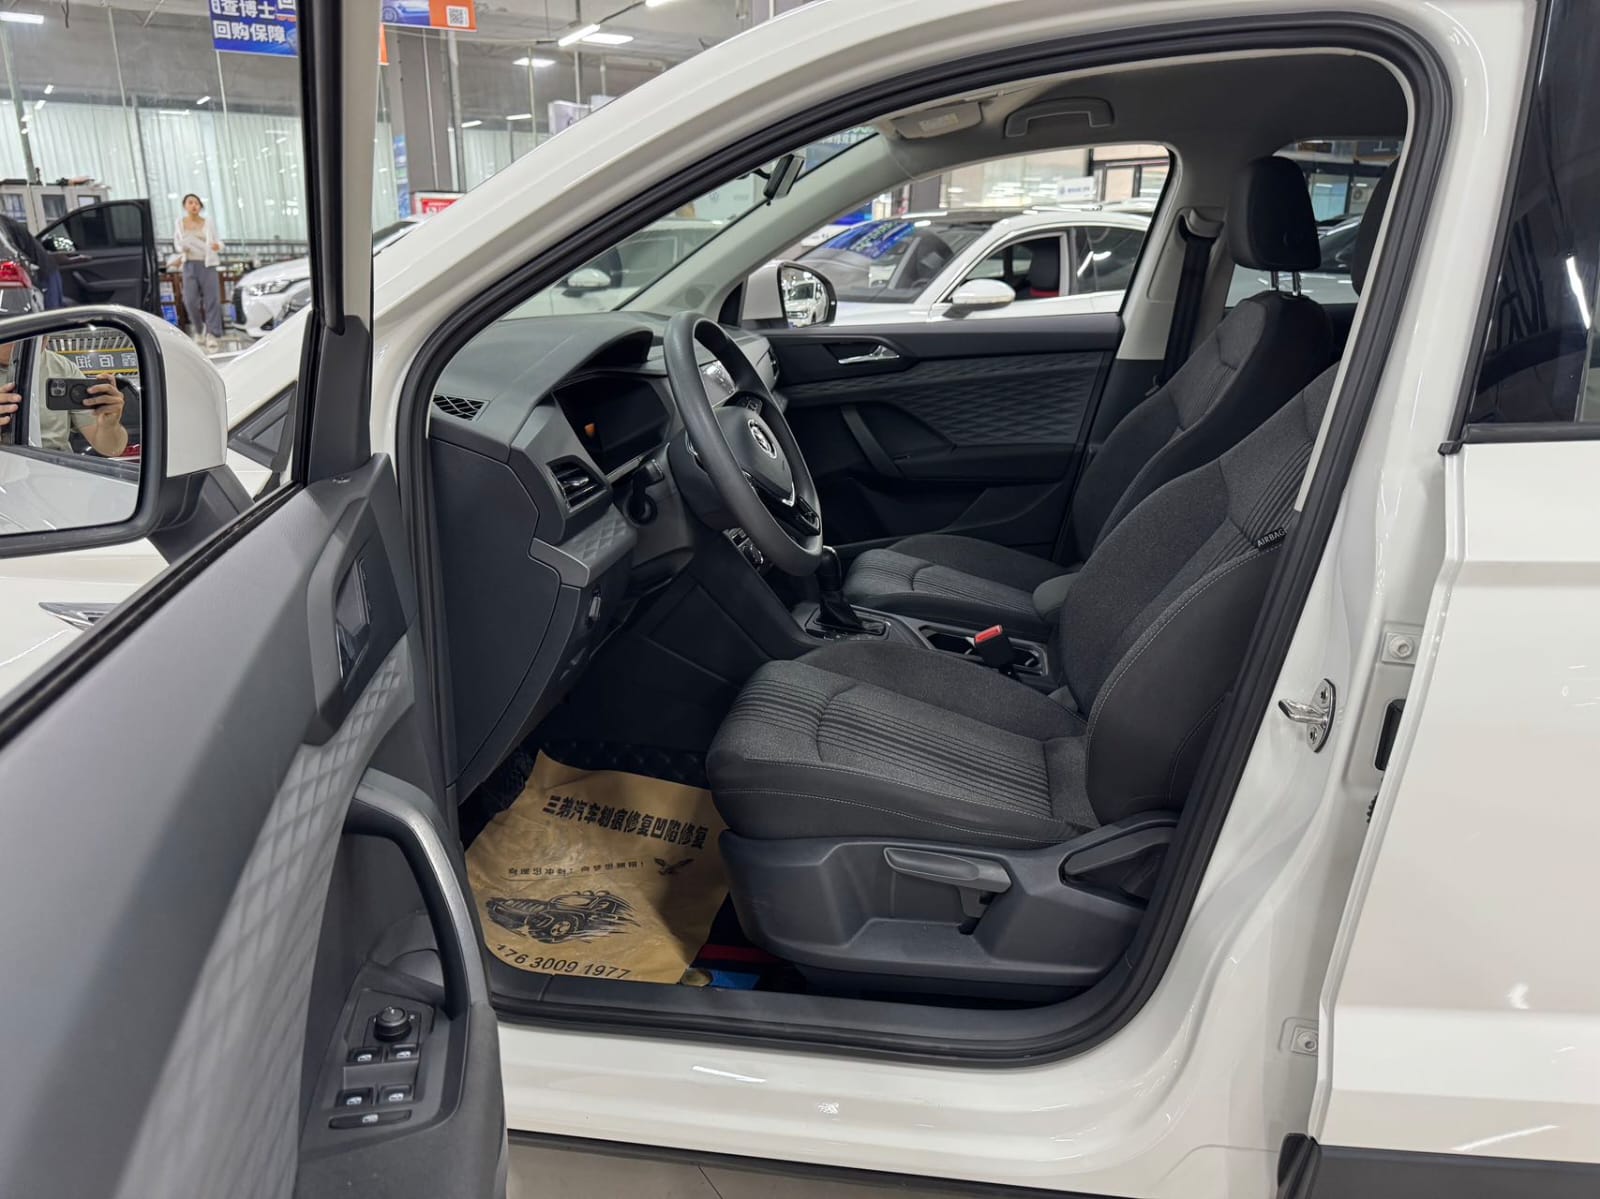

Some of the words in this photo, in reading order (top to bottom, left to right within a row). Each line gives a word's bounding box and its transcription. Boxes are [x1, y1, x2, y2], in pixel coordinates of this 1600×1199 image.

[213, 20, 286, 43] 回购保障
[1257, 528, 1287, 547] AIRBAG
[496, 943, 528, 964] 176
[529, 956, 579, 973] 3009
[584, 963, 631, 979] 1977
